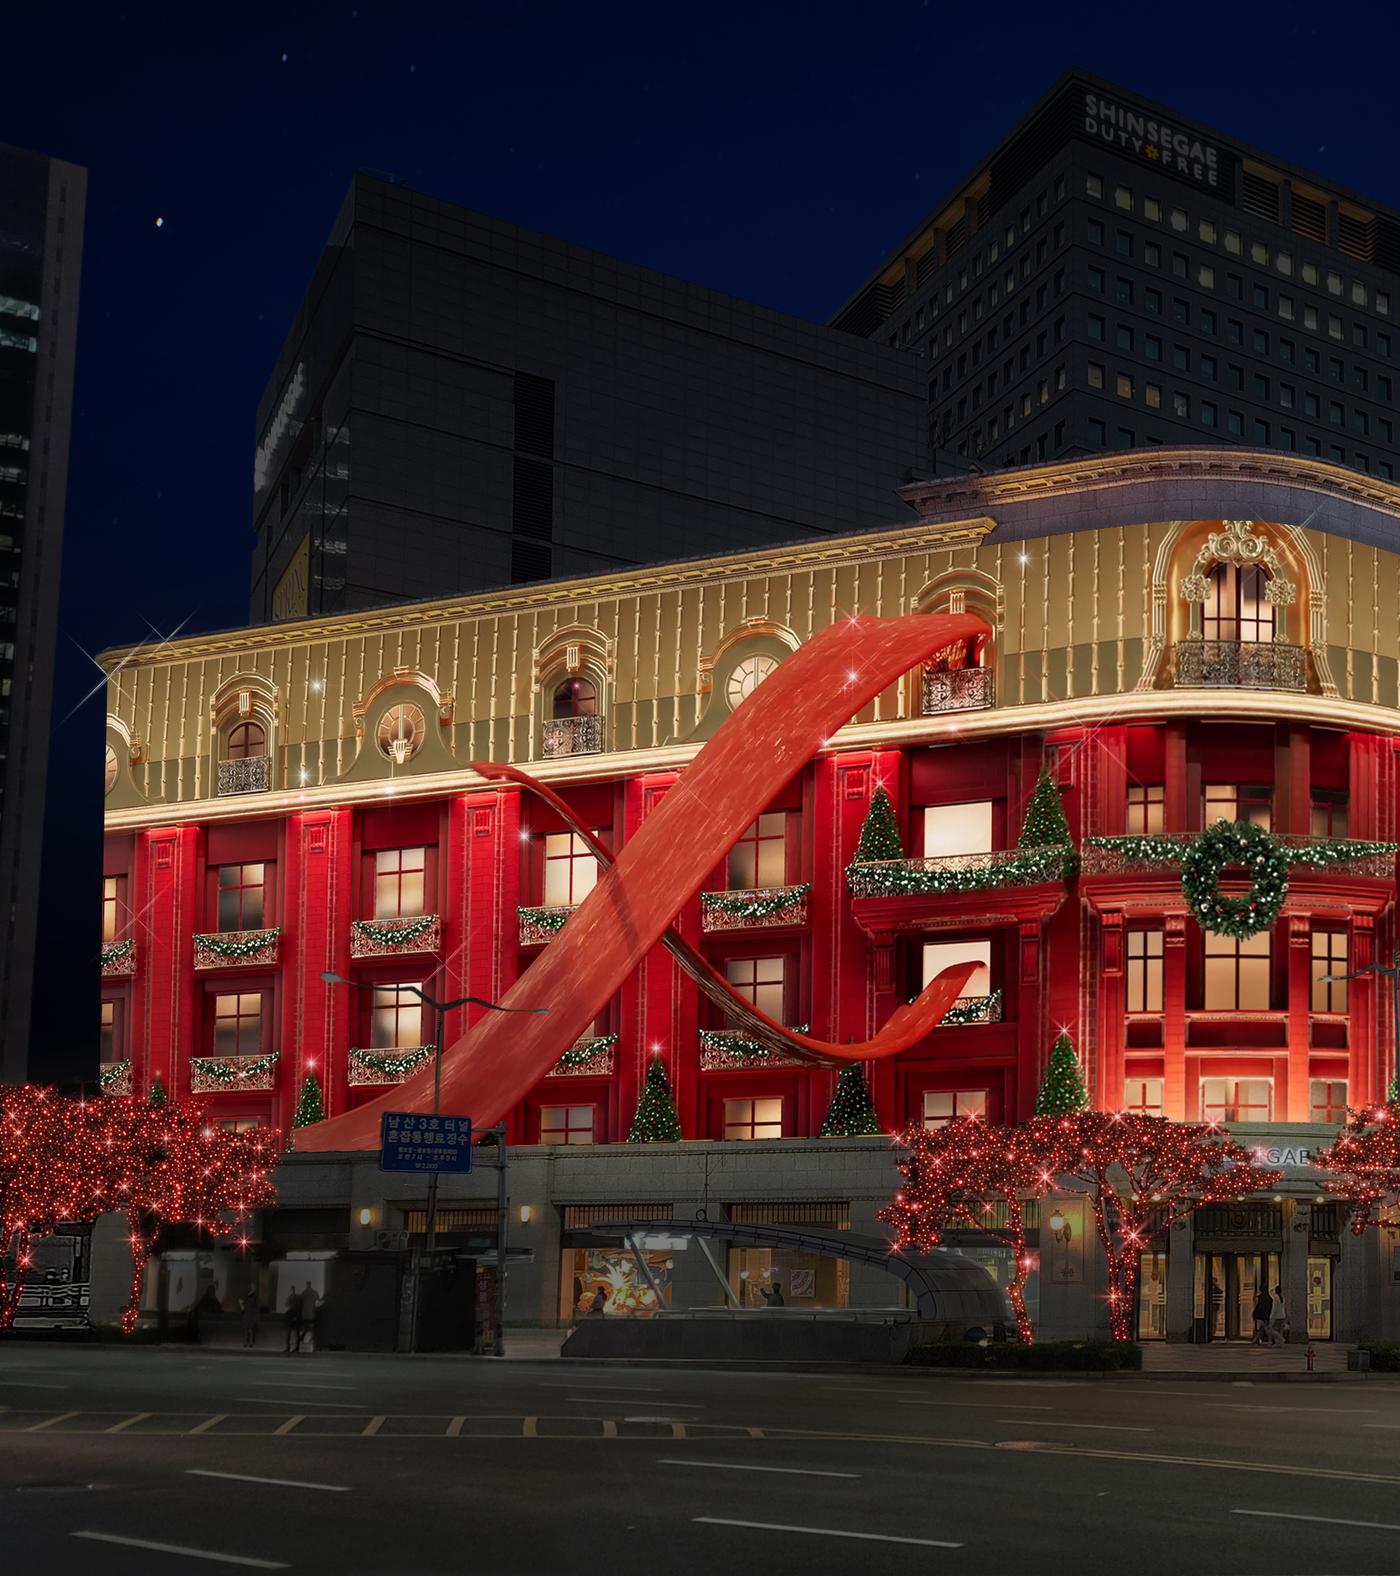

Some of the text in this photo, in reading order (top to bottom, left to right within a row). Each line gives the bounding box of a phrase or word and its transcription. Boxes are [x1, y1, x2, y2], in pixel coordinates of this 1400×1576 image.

[1085, 94, 1217, 169] SHINSEGAE
[1085, 117, 1217, 187] DUTY FREE
